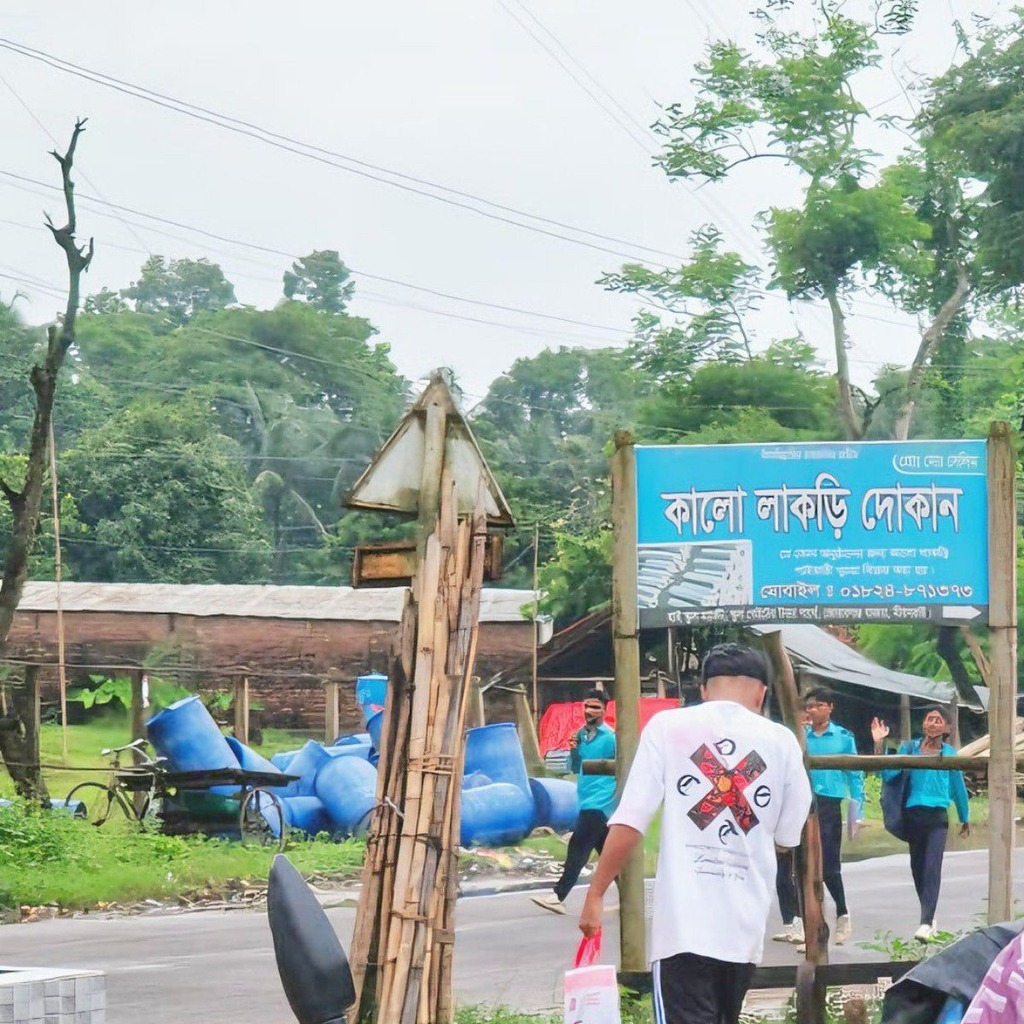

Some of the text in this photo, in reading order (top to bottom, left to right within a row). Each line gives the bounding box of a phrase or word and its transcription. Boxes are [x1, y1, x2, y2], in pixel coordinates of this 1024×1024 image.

[661, 472, 964, 539] কালো লাকড়ি দোকান
